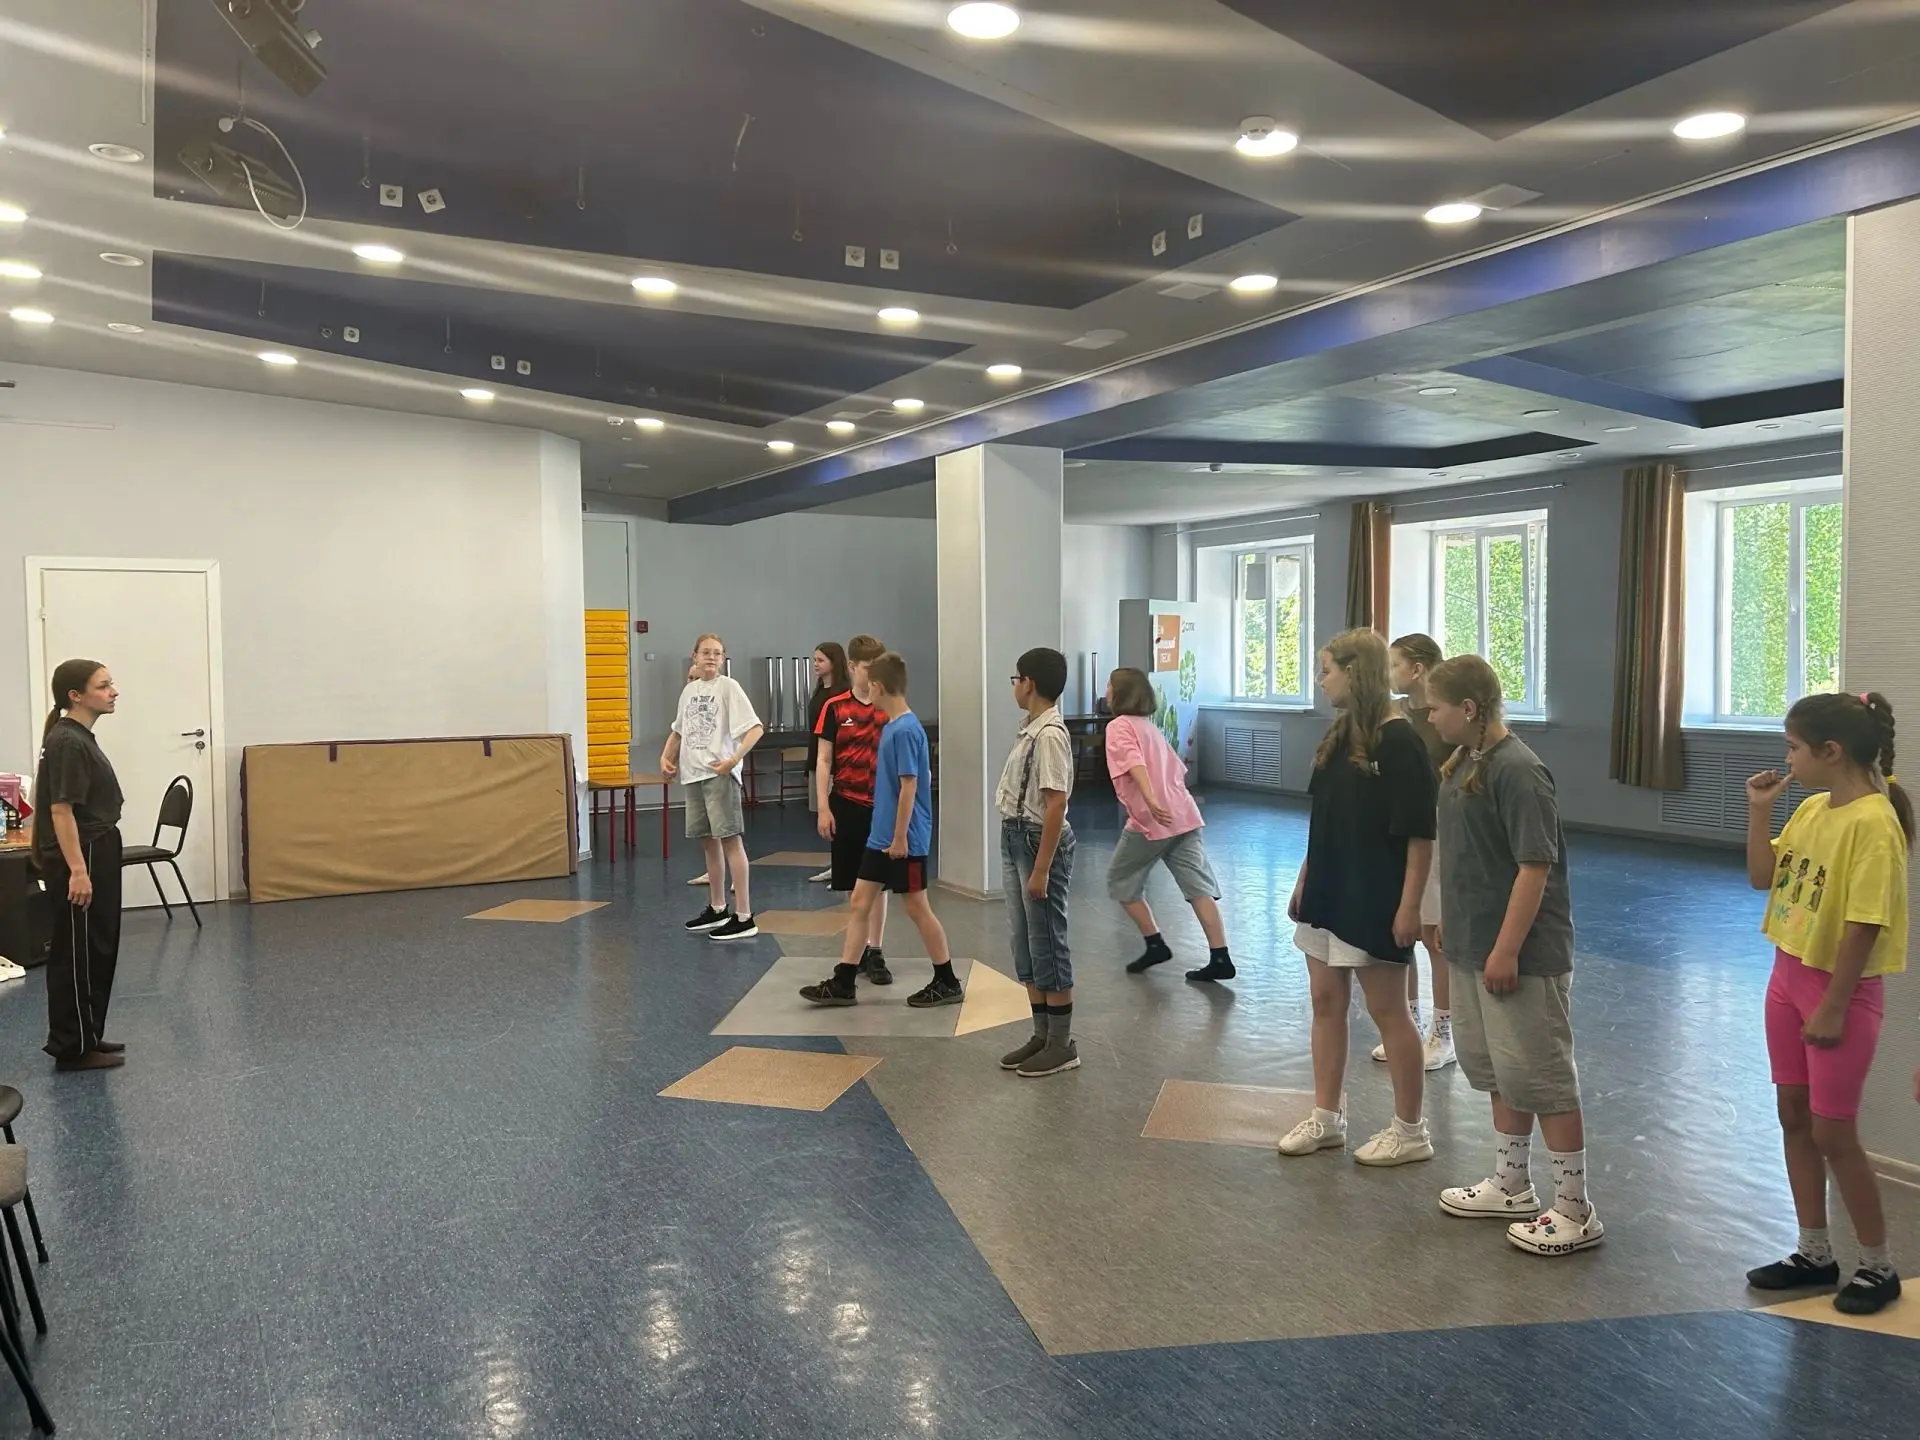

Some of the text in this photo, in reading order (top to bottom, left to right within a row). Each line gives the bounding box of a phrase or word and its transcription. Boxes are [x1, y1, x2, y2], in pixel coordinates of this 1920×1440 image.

[699, 695, 710, 703] JUST
[1506, 1161, 1528, 1169] PLAY
[1558, 1194, 1584, 1205] PLAY
[1538, 1242, 1574, 1253] crocs
